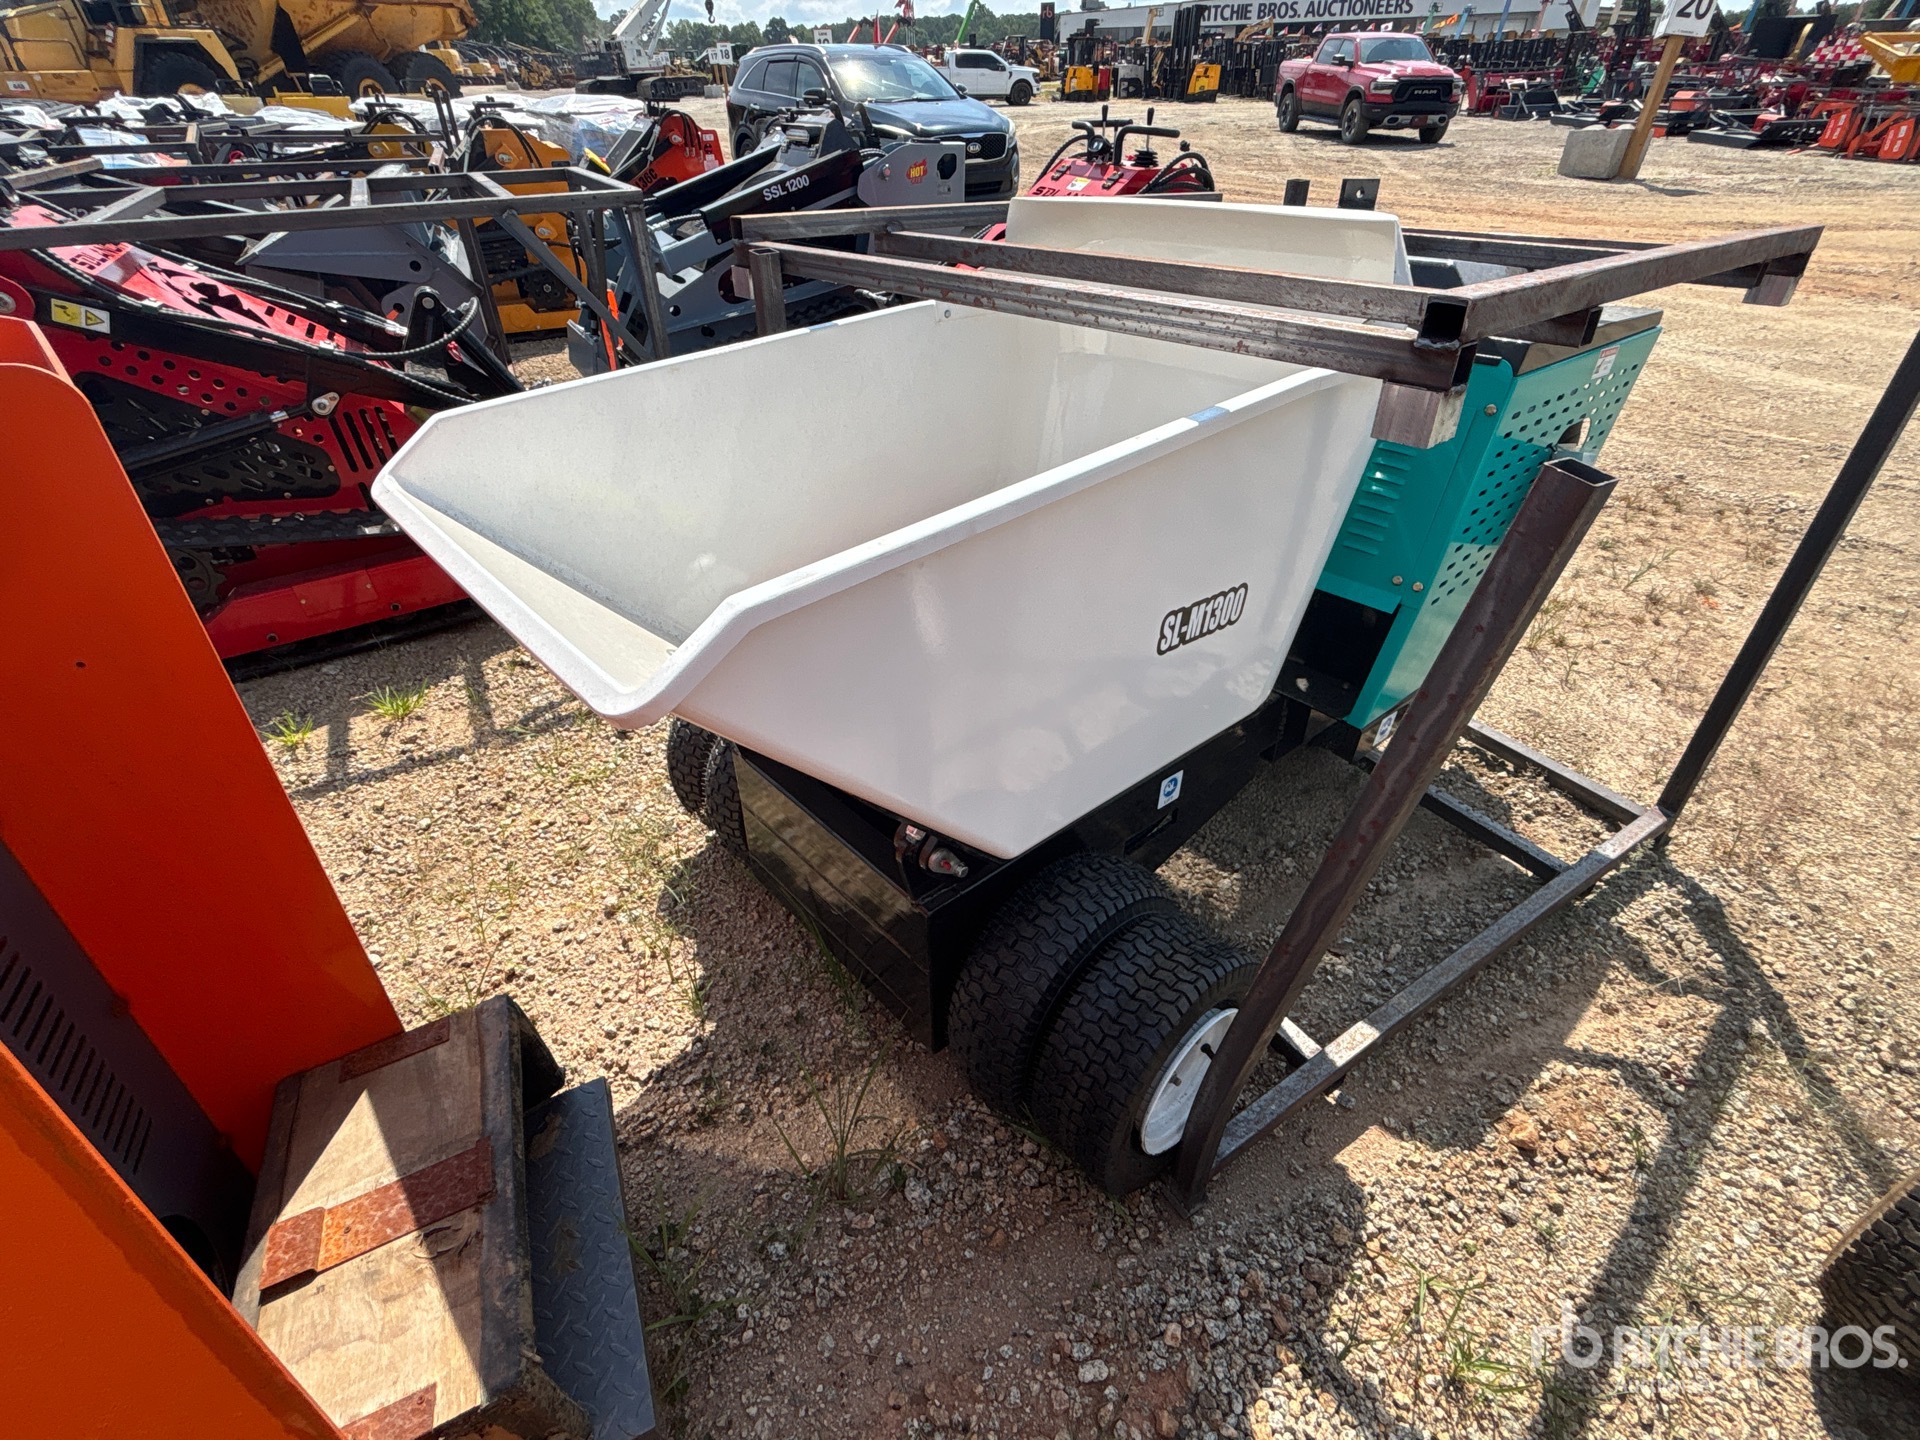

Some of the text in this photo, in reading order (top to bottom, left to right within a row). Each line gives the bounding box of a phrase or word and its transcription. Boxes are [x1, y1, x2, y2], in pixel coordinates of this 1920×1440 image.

[1257, 1, 1301, 20] BROS.
[1304, 0, 1413, 18] AUCTIONEERS
[1676, 0, 1714, 20] 20
[719, 49, 730, 60] 18
[969, 144, 980, 152] KIA
[909, 165, 925, 179] HOT
[762, 174, 810, 201] SSL 1200
[1158, 583, 1247, 655] SL-M1300
